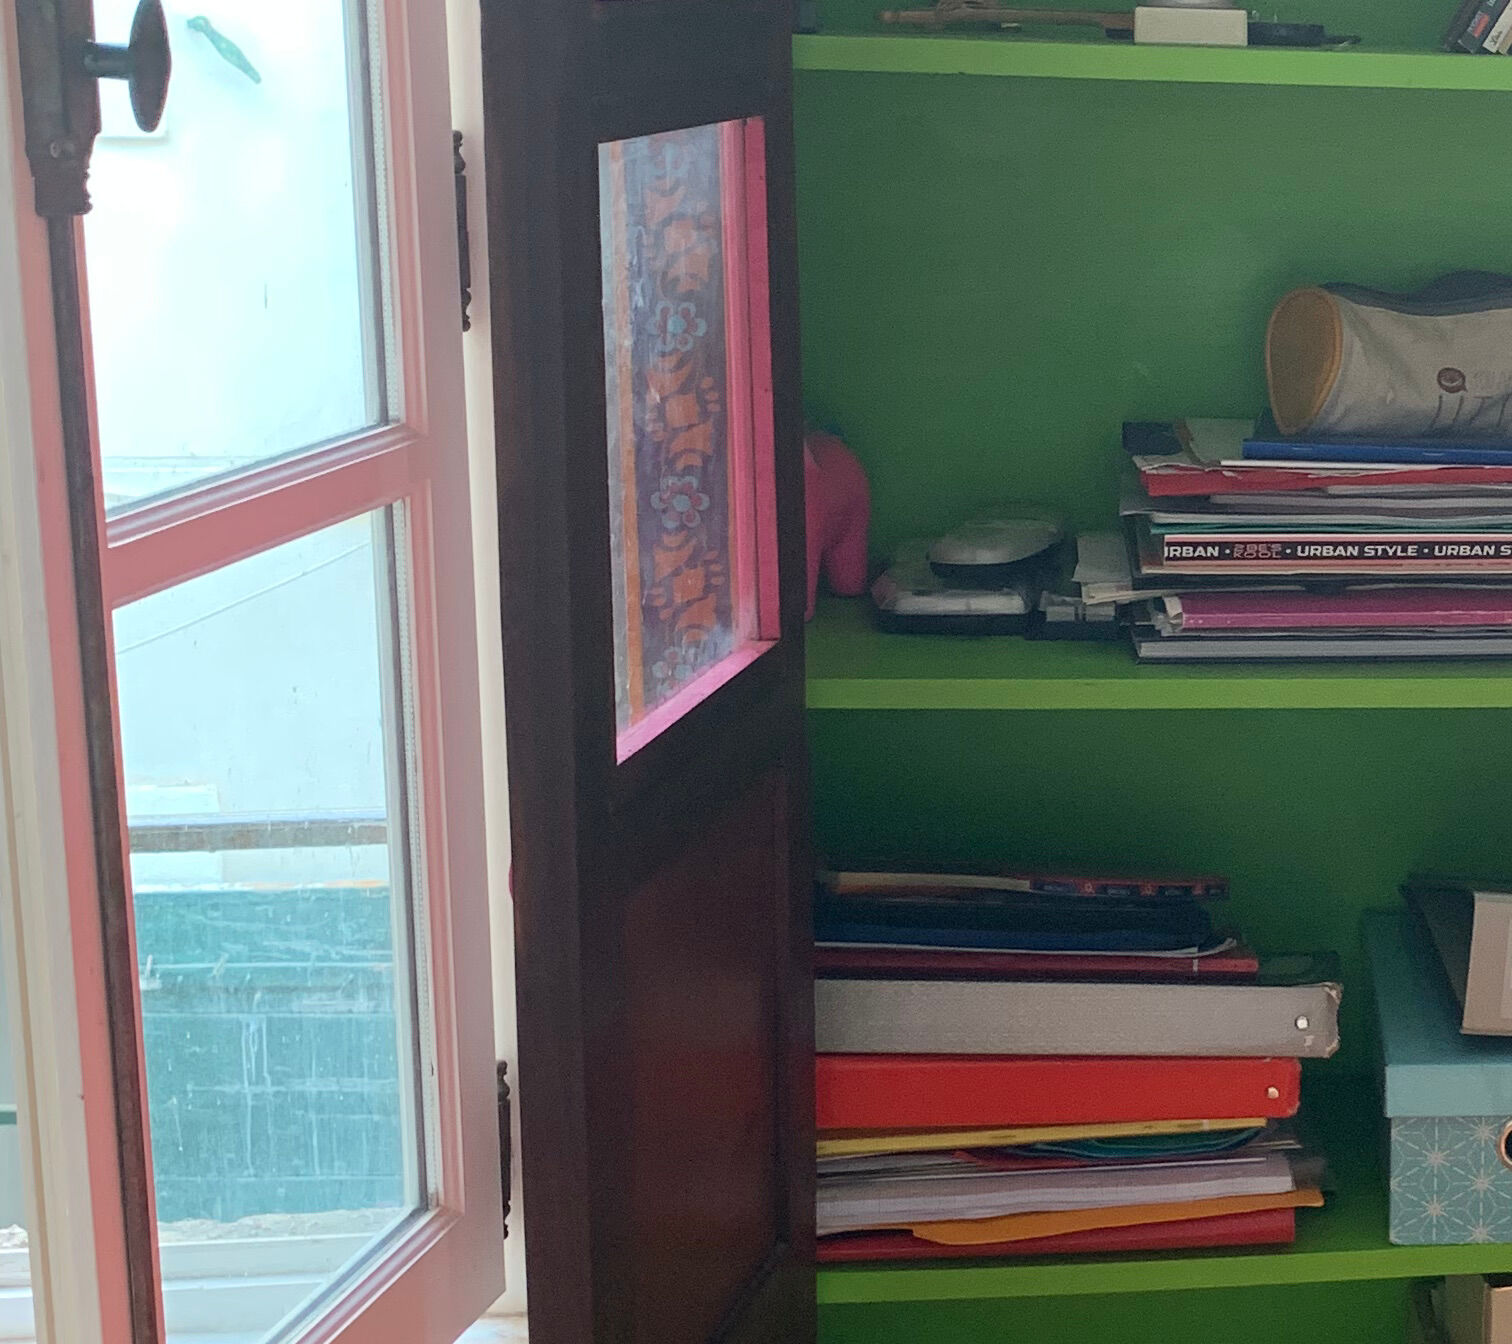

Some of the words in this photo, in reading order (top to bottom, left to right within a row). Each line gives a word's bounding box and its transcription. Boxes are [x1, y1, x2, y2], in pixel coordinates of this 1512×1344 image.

[1296, 545, 1362, 557] URBAN
[1363, 545, 1418, 557] STYLE
[1433, 545, 1496, 556] URBAN
